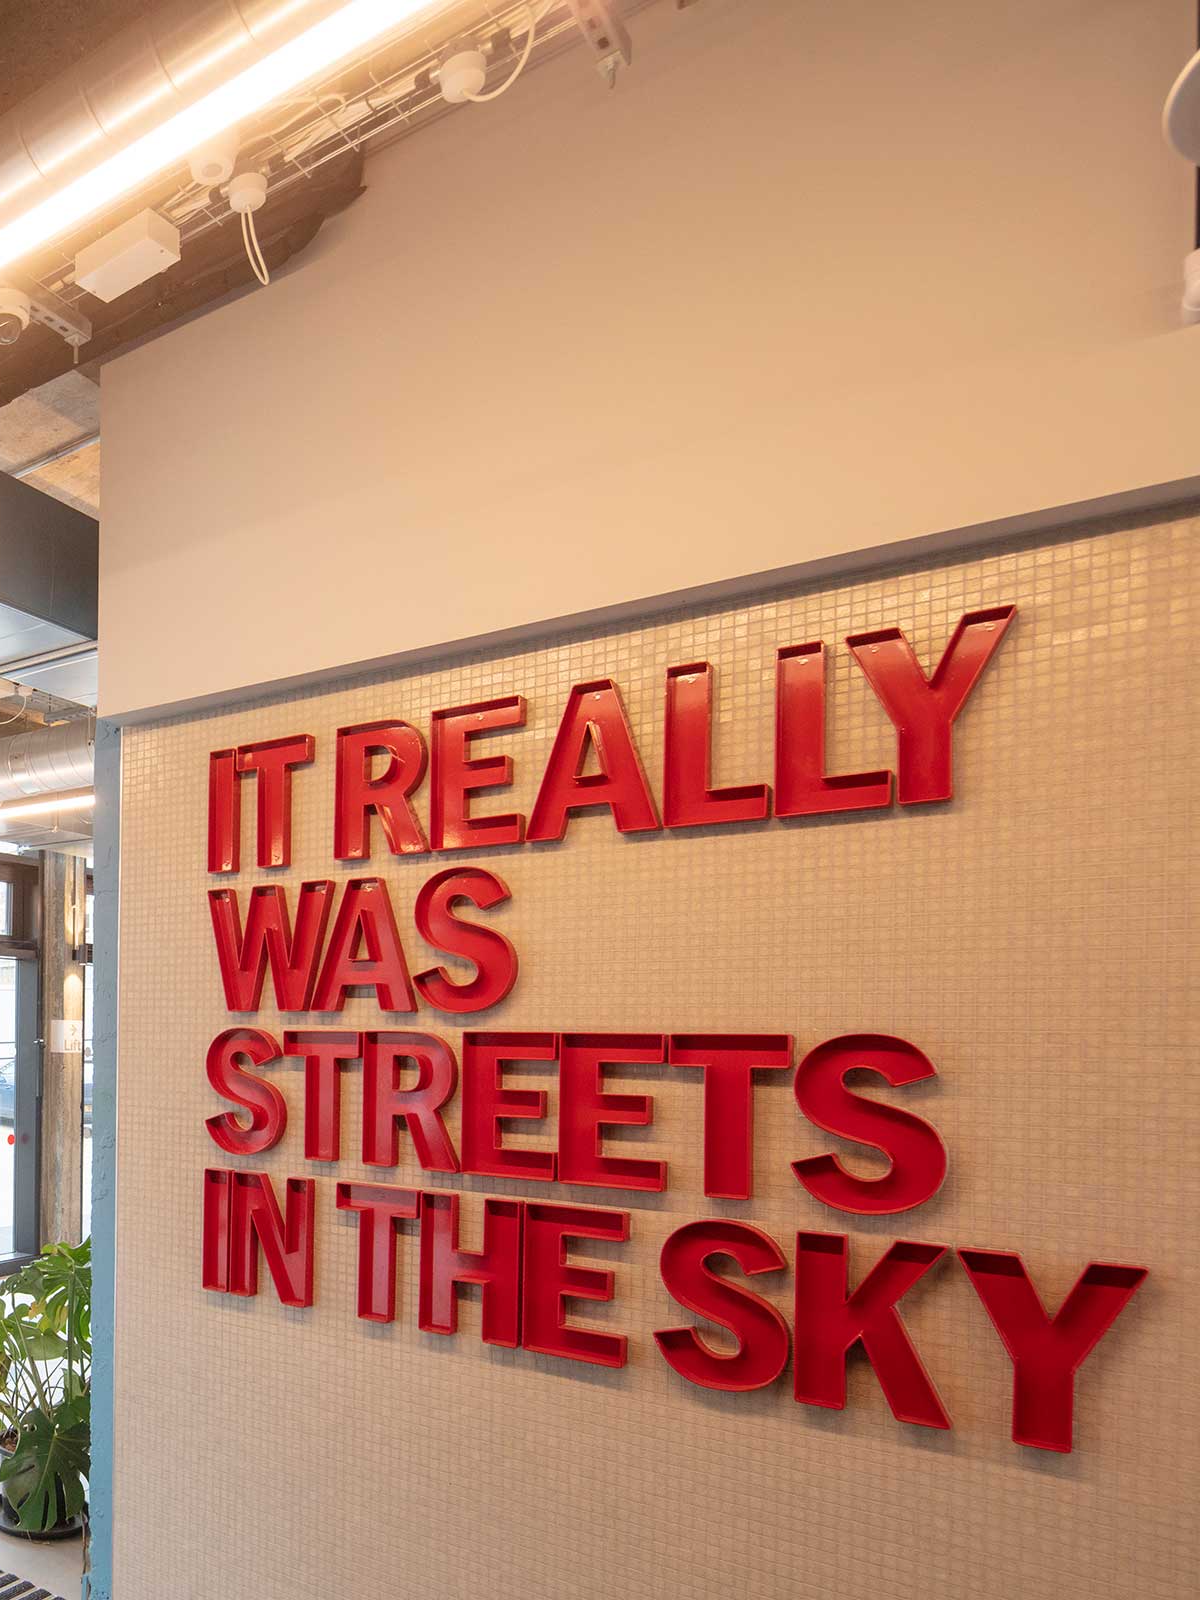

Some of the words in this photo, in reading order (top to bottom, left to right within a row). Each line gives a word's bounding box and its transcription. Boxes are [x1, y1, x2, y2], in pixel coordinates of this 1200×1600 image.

[208, 735, 315, 873] IT
[334, 606, 1016, 860] REALLY
[208, 866, 518, 1014] WAS
[64, 1039, 82, 1051] Lift
[204, 1028, 946, 1216] STREETS
[203, 1169, 316, 1307] IN
[336, 1183, 631, 1369] THE
[653, 1219, 1150, 1454] SKY
